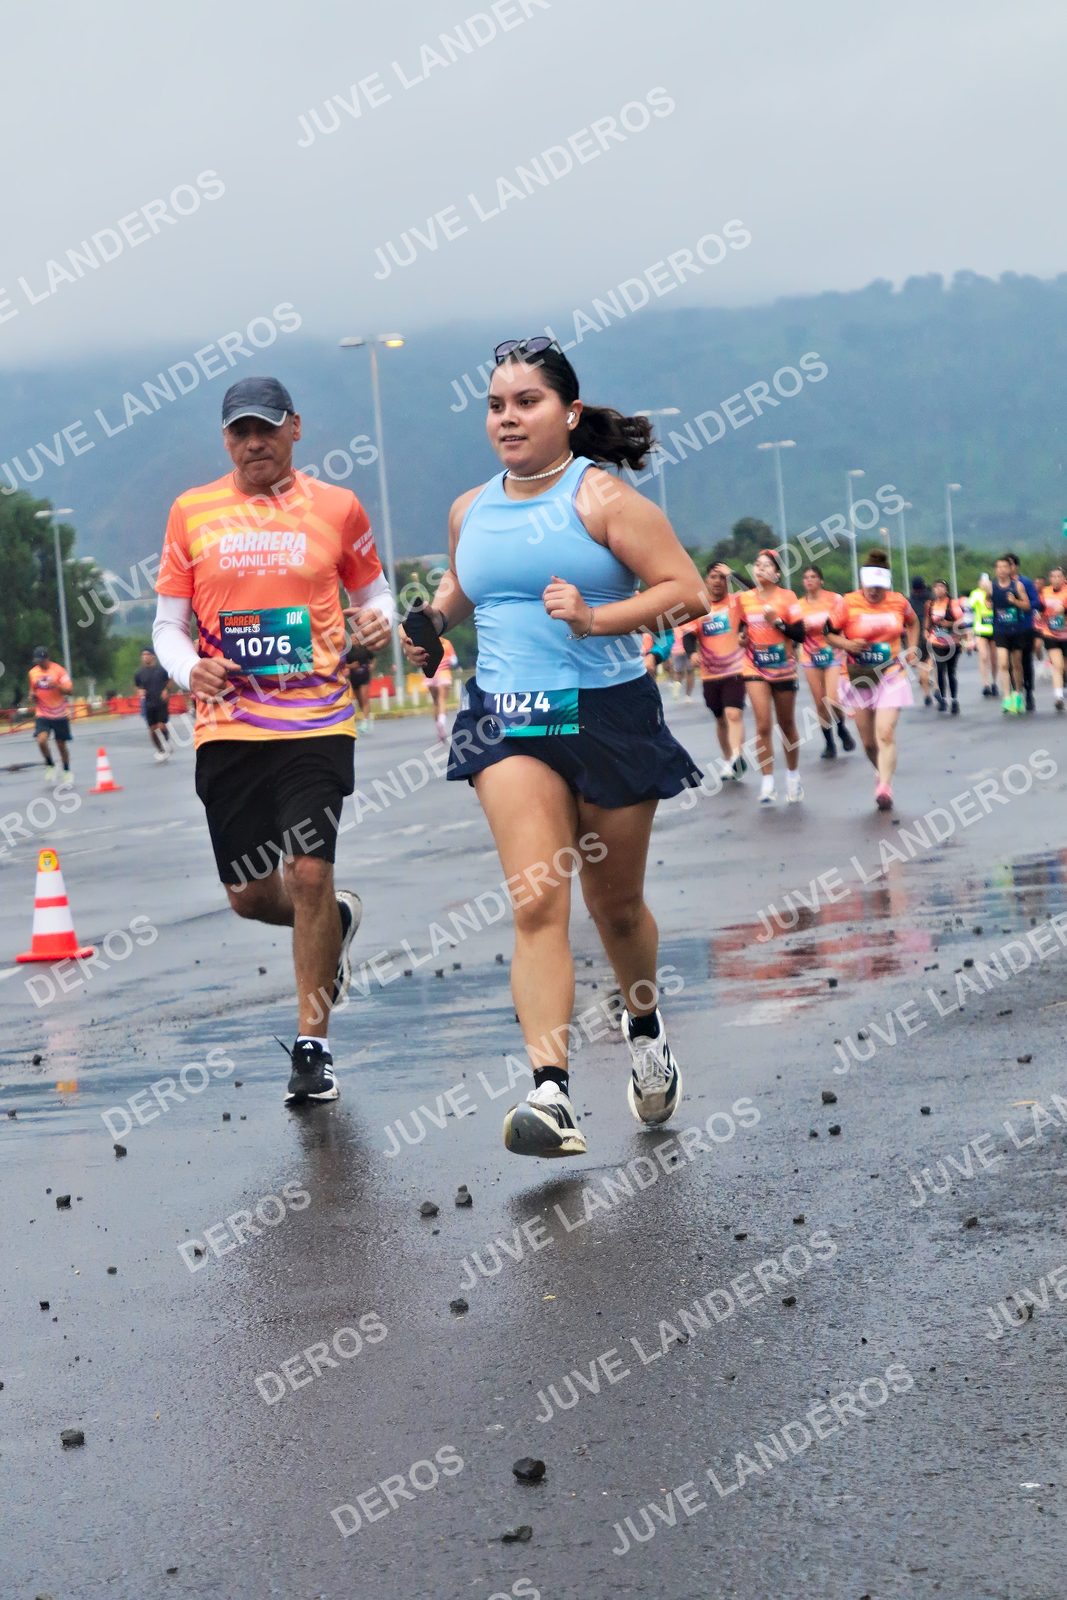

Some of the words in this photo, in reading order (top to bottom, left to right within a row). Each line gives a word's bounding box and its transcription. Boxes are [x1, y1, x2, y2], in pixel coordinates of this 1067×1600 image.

[219, 531, 306, 554] CARRERA
[219, 553, 286, 569] OMNILIFE
[224, 615, 260, 627] CARRERA
[286, 611, 303, 625] 10K
[224, 626, 252, 635] OMNILIFE
[235, 635, 291, 657] 1076
[493, 691, 551, 714] 1024
